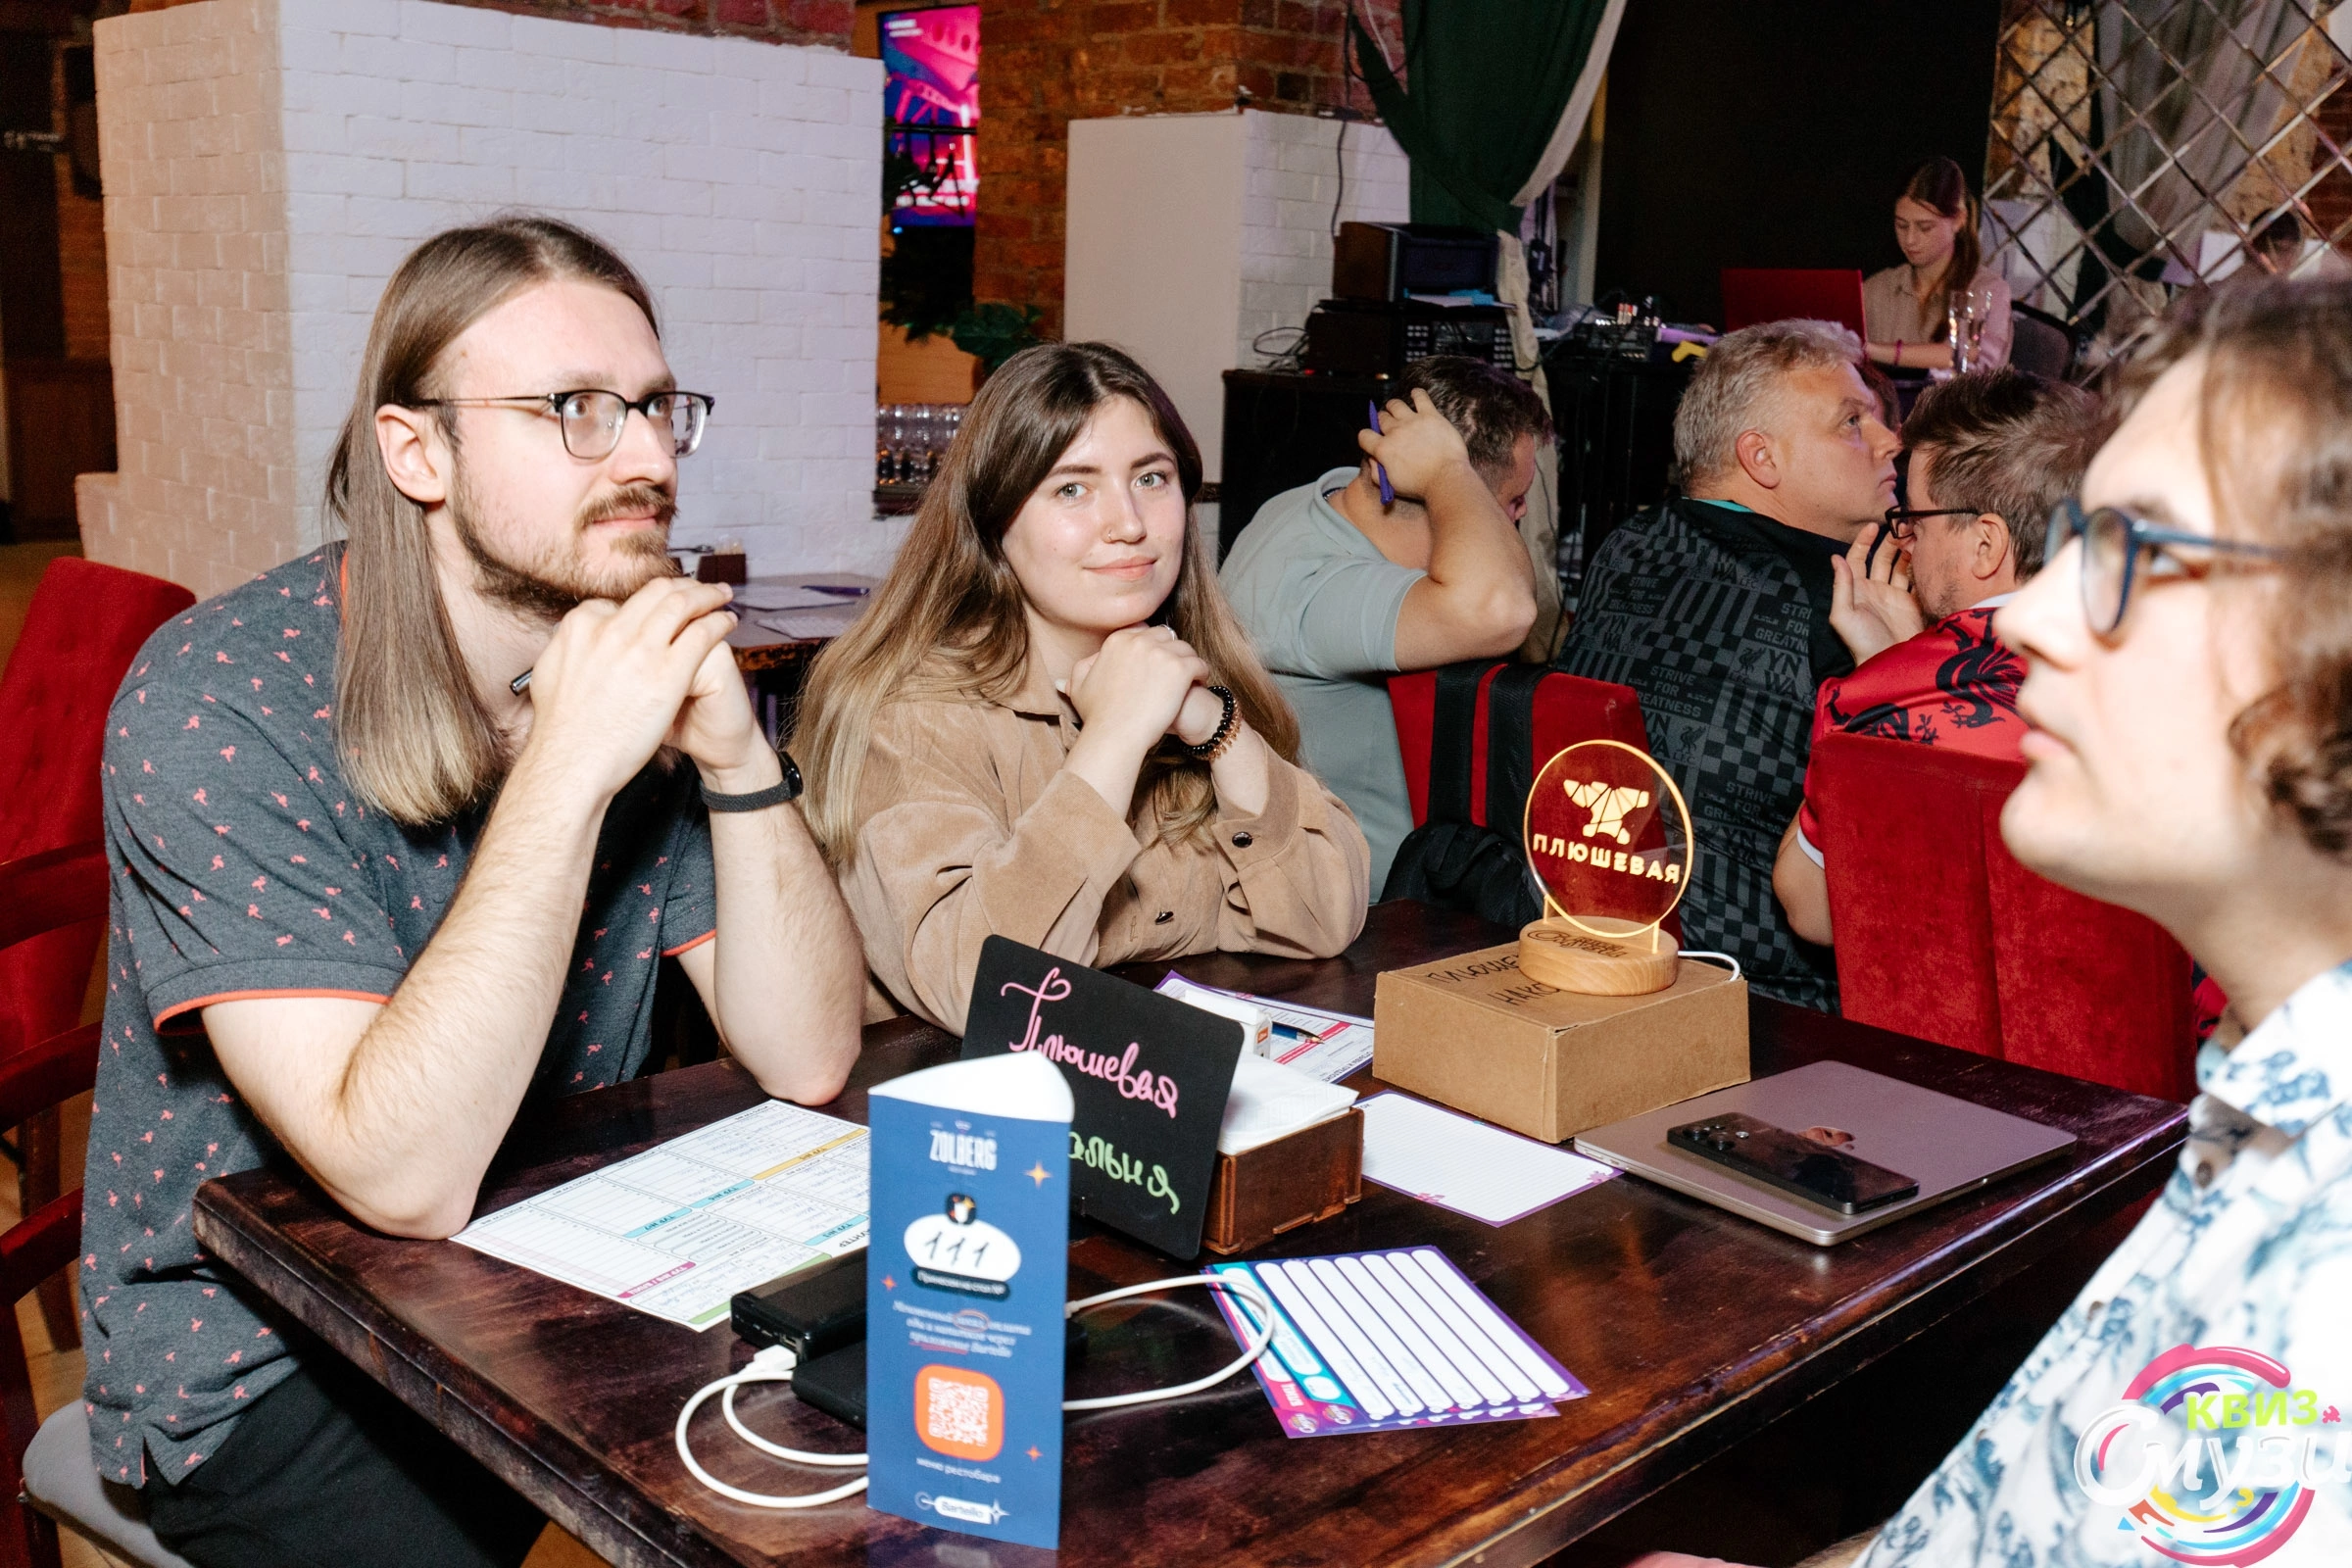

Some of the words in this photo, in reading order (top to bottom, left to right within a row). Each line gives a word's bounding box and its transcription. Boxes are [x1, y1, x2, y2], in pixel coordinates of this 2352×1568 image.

[1780, 602, 1811, 620] STRI
[1754, 627, 1809, 654] GREATN
[1649, 665, 1697, 686] STRIVE
[1768, 648, 1803, 676] YN
[1653, 680, 1680, 697] FOR
[1763, 669, 1799, 700] WA
[1638, 692, 1702, 718] REATNESS
[1726, 780, 1778, 807] STRIVE
[1734, 798, 1762, 815] FOR
[1533, 833, 1681, 884] ПЛЮШЕВАЯ
[1427, 954, 1520, 984] ПЛЮШЕ
[1739, 956, 1762, 972] IVE
[1487, 983, 1561, 1006] НАКО
[930, 1128, 998, 1171] ZOLBERG
[1067, 1131, 1181, 1215] альня
[924, 1230, 990, 1268] 111
